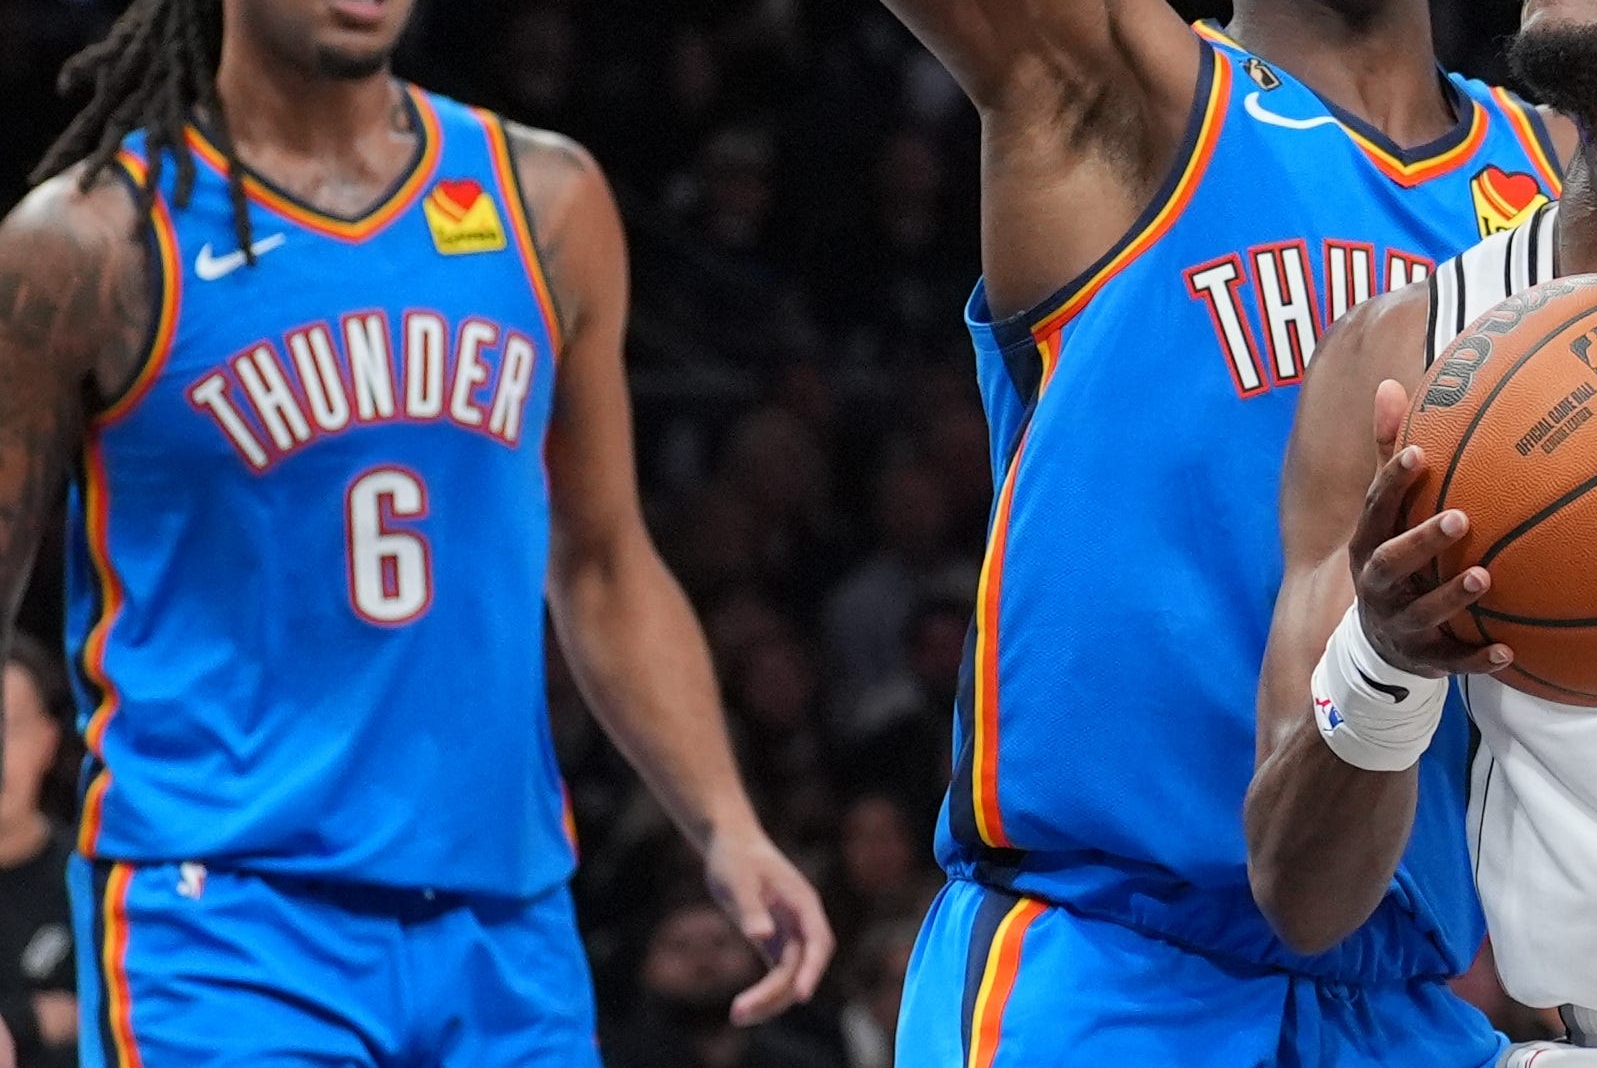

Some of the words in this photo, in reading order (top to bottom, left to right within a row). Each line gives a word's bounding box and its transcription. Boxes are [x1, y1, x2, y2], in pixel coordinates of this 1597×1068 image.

[184, 309, 537, 474] THUNDER
[1515, 417, 1556, 456] OFFICIAL
[1548, 396, 1577, 424] GAME
[1570, 381, 1597, 405] BALL
[345, 463, 433, 627] 6
